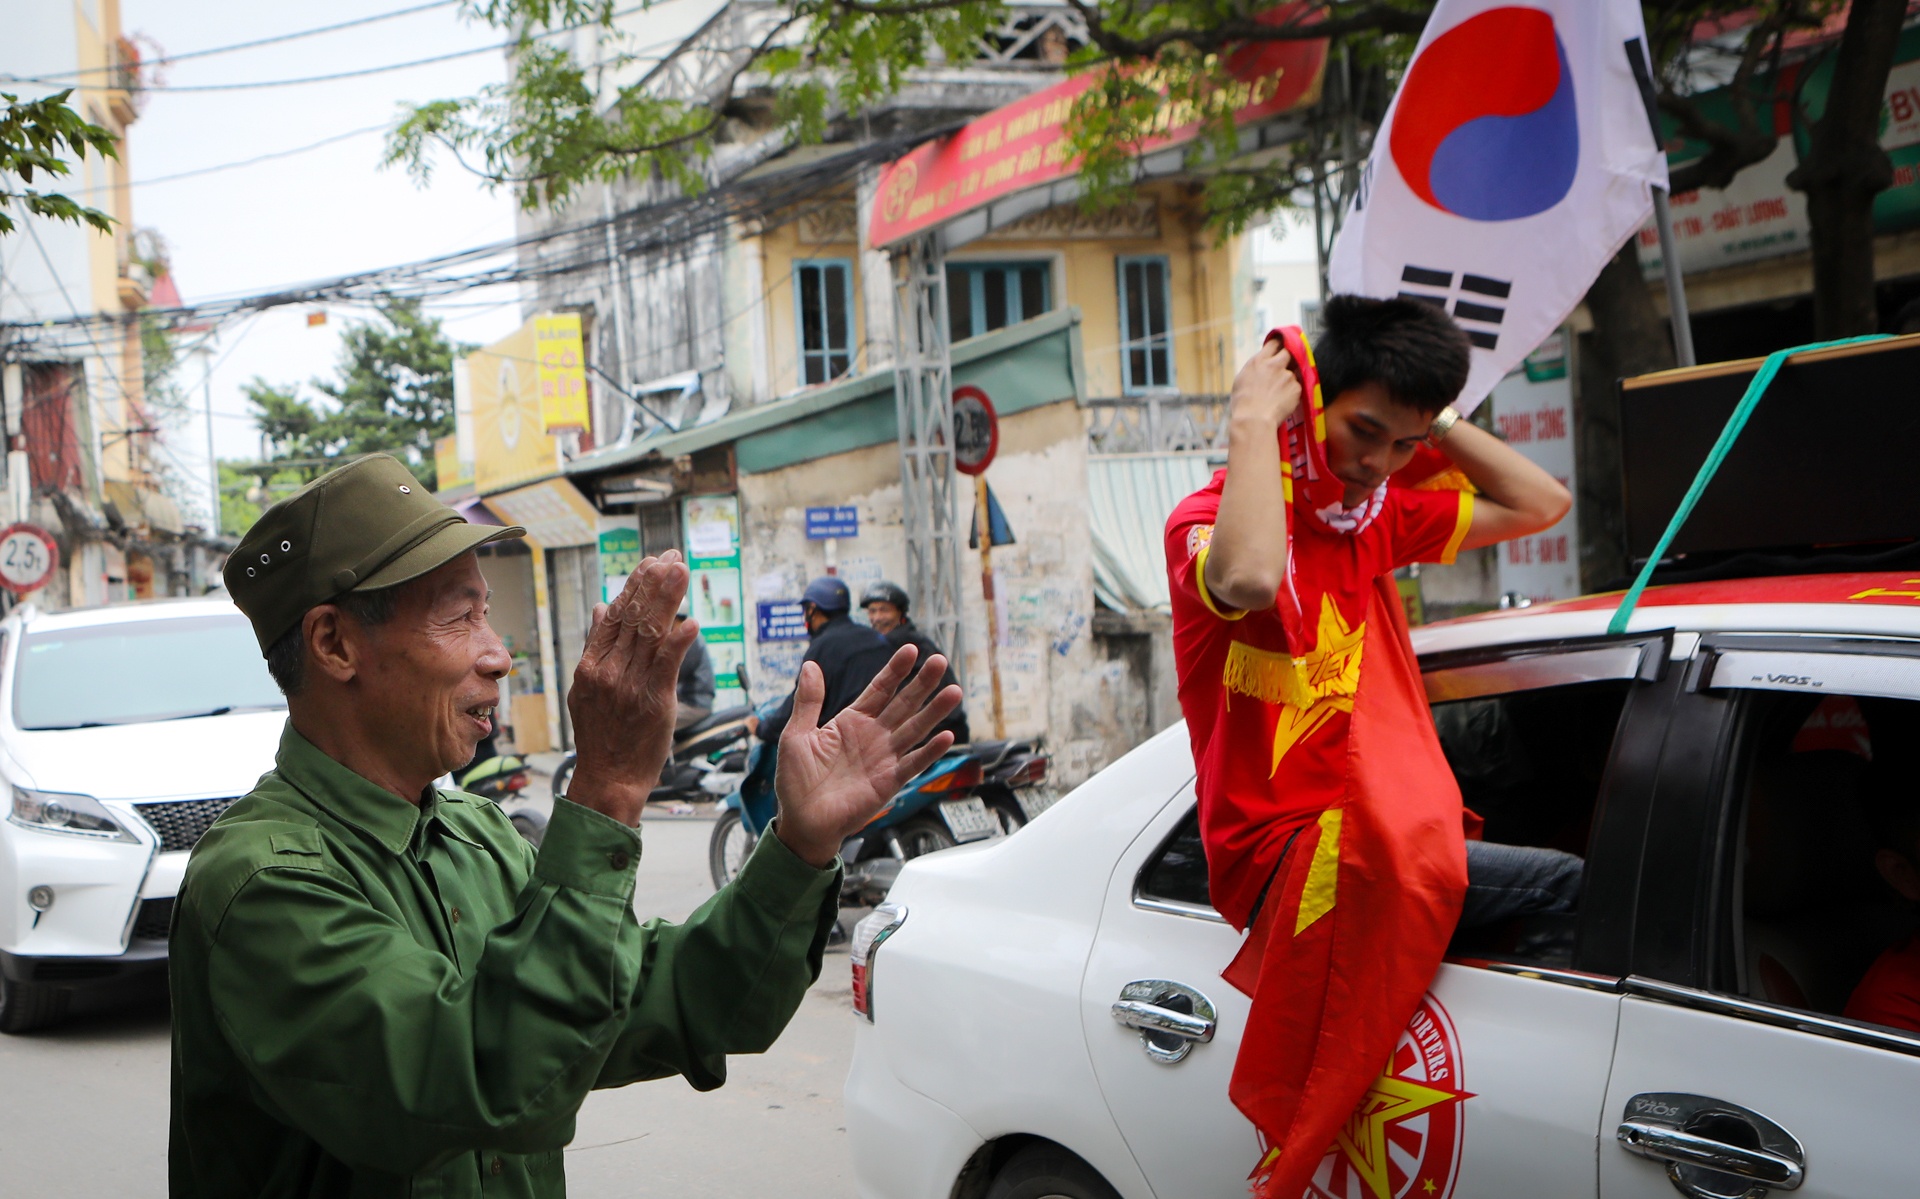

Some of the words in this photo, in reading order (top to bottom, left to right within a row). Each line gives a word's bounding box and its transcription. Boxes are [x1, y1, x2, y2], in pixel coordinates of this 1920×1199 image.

[1768, 673, 1811, 685] VIOS
[1410, 1010, 1448, 1082] ORTERS
[1635, 1102, 1680, 1116] VIOS
